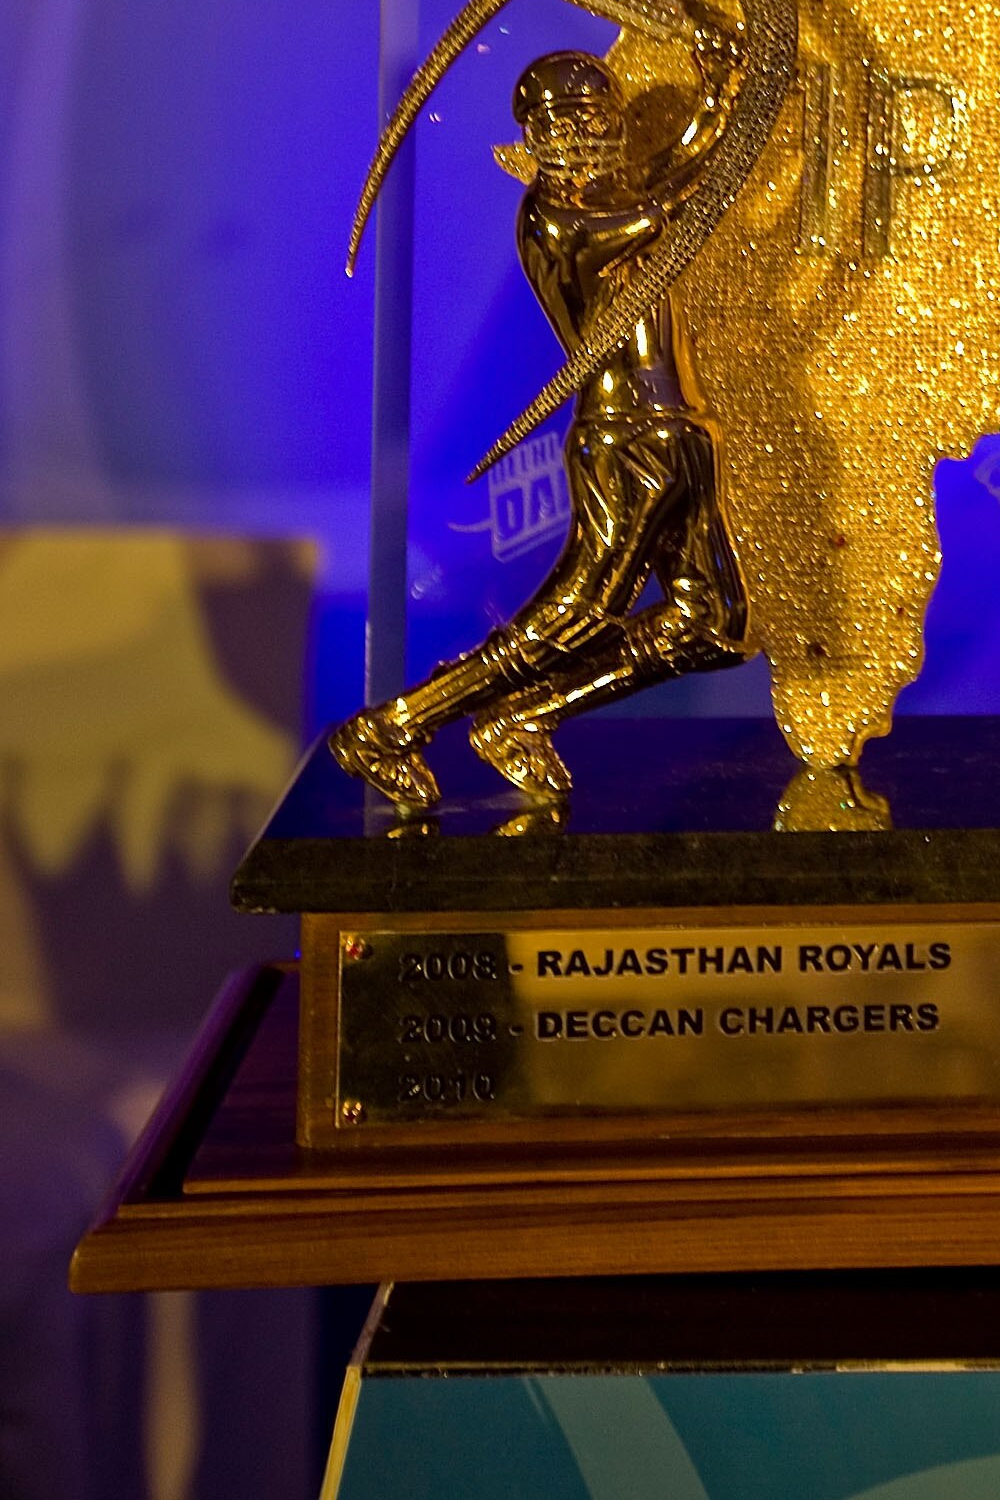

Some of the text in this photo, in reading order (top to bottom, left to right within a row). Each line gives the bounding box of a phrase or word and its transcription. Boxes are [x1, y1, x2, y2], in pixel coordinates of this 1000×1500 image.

[401, 951, 497, 981] 2008
[537, 947, 782, 977] RAJASTHAN
[799, 942, 952, 972] ROYALS
[401, 1011, 497, 1044] 2009
[537, 1009, 703, 1040] DECCAN
[719, 1003, 941, 1036] CHARGERS
[401, 1071, 495, 1100] 2010
